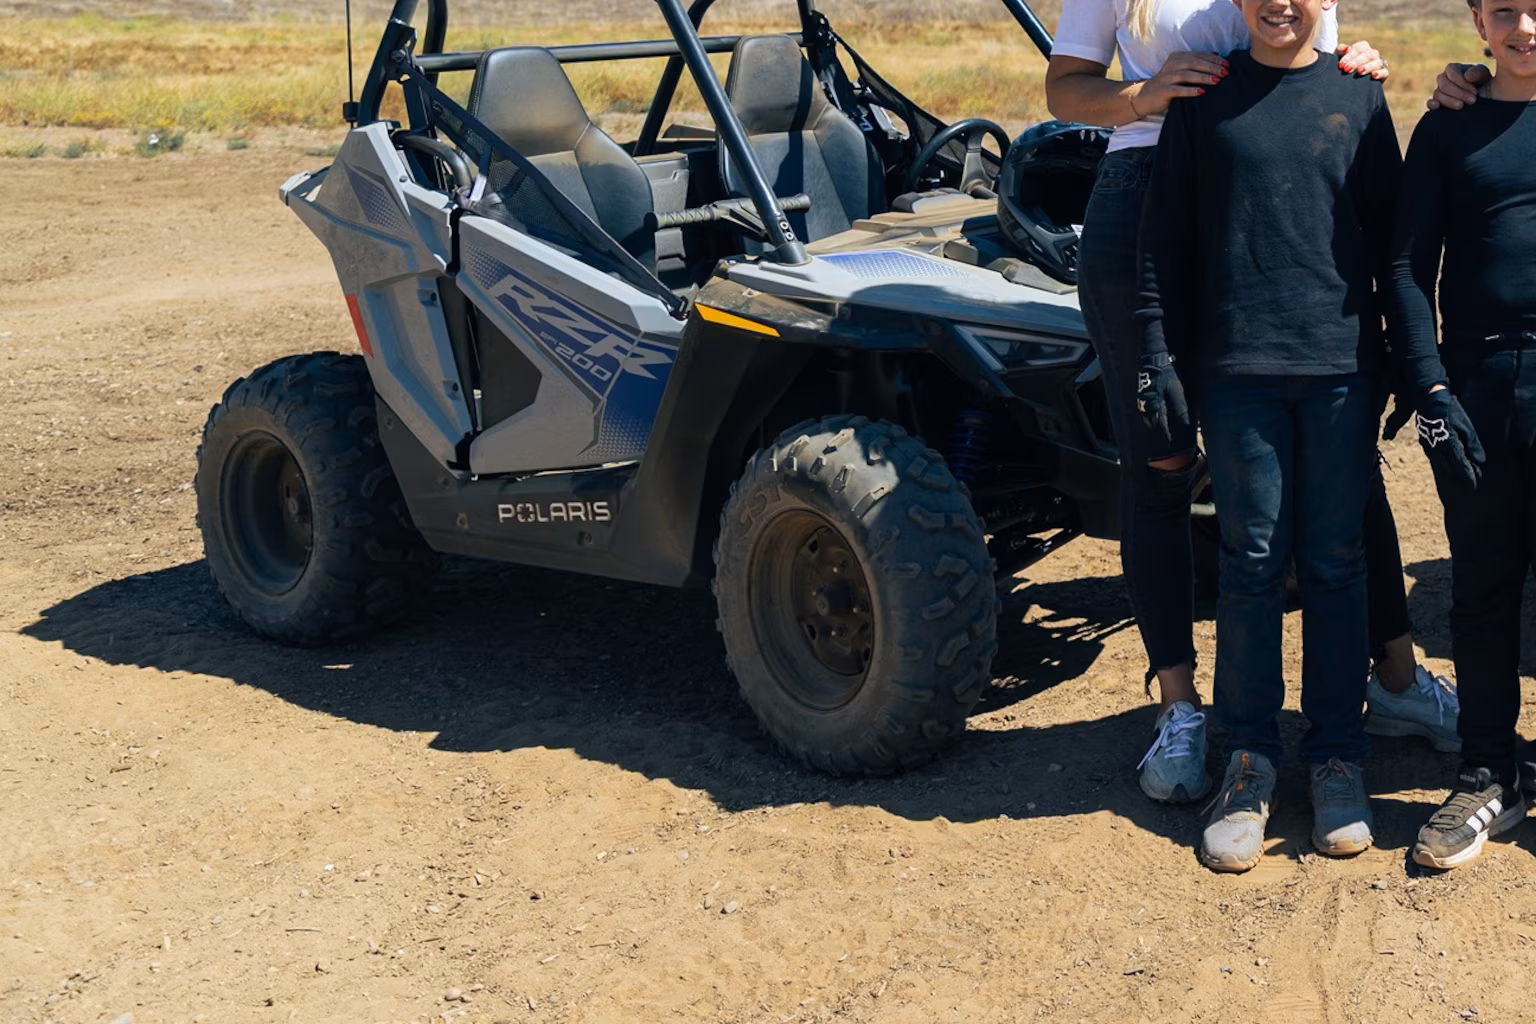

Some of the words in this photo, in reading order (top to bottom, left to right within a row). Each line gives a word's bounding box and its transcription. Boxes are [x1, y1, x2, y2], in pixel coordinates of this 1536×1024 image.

[485, 274, 674, 380] RZR
[555, 342, 612, 382] 200
[497, 501, 611, 523] POLARIS
